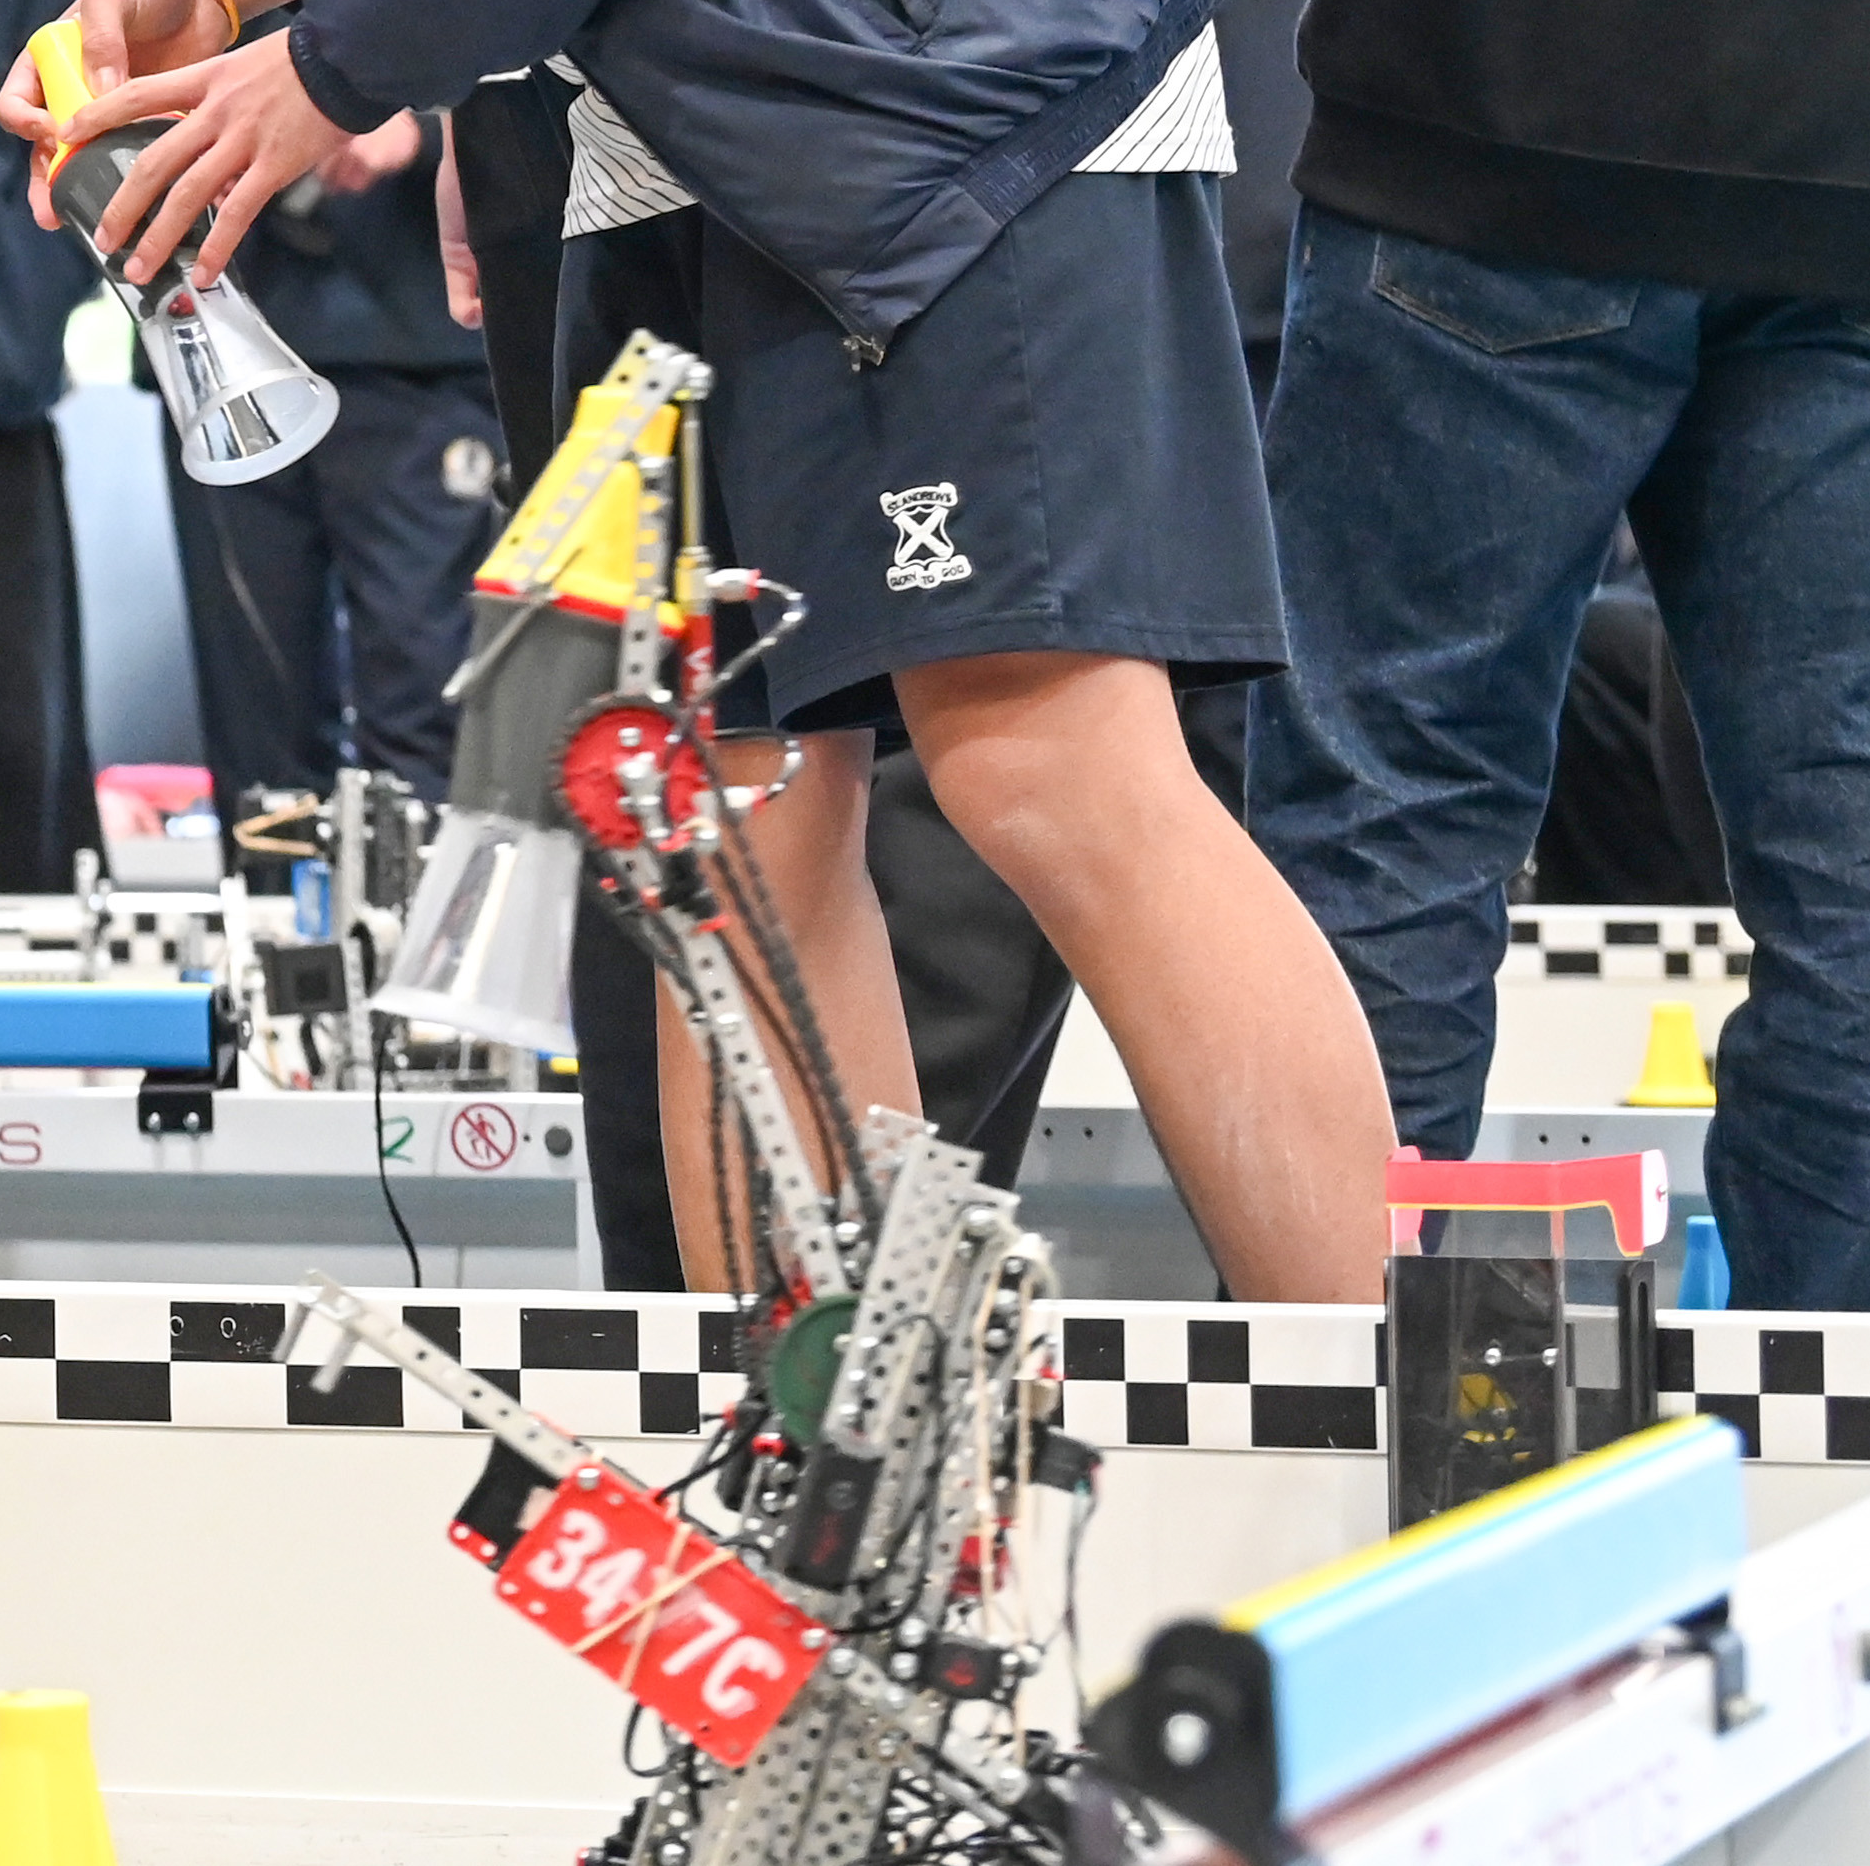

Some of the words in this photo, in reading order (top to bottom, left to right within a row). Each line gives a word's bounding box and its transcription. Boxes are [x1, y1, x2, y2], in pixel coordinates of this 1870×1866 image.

[921, 575, 936, 585] TO
[942, 564, 965, 578] GOD
[380, 1115, 414, 1163] 2
